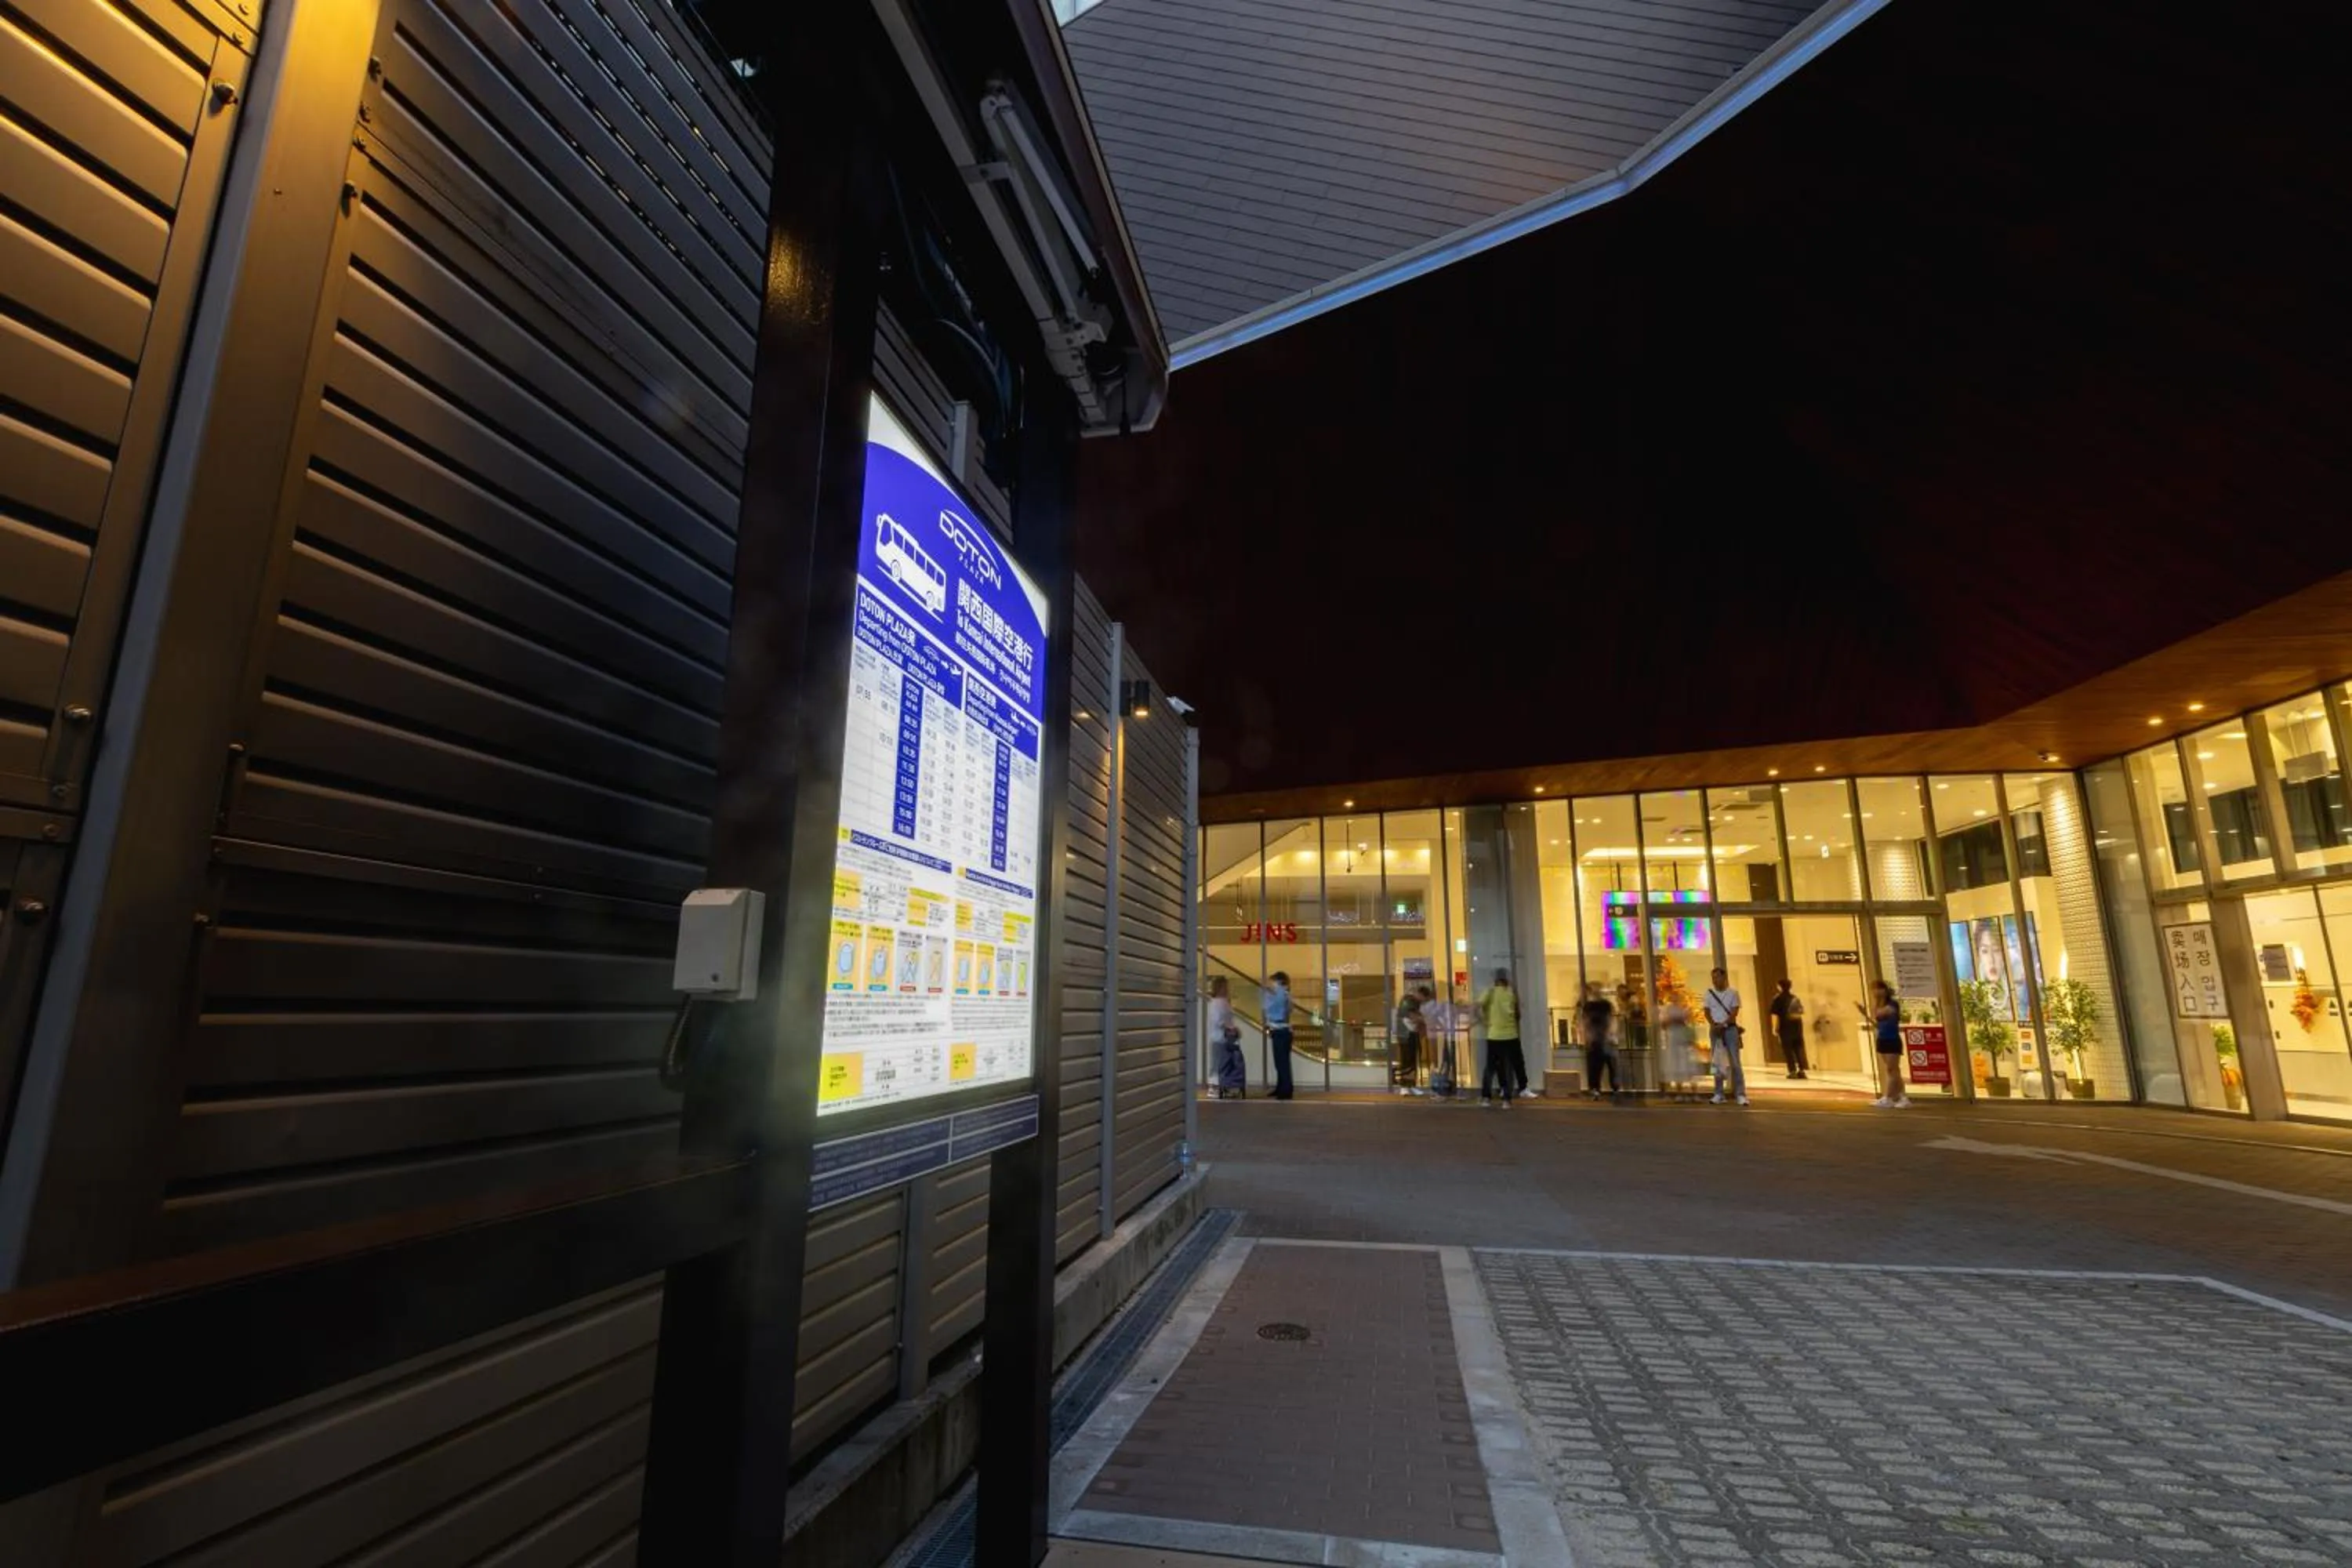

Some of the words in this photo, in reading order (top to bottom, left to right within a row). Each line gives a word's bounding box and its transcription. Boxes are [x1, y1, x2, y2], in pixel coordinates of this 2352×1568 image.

[939, 510, 1001, 591] DOTON
[958, 553, 984, 586] PLAZA
[860, 592, 885, 625] DOTON
[957, 575, 1033, 673] 関西国際空港行
[858, 609, 887, 644] Departing
[887, 632, 900, 650] from
[1241, 923, 1297, 943] JINS
